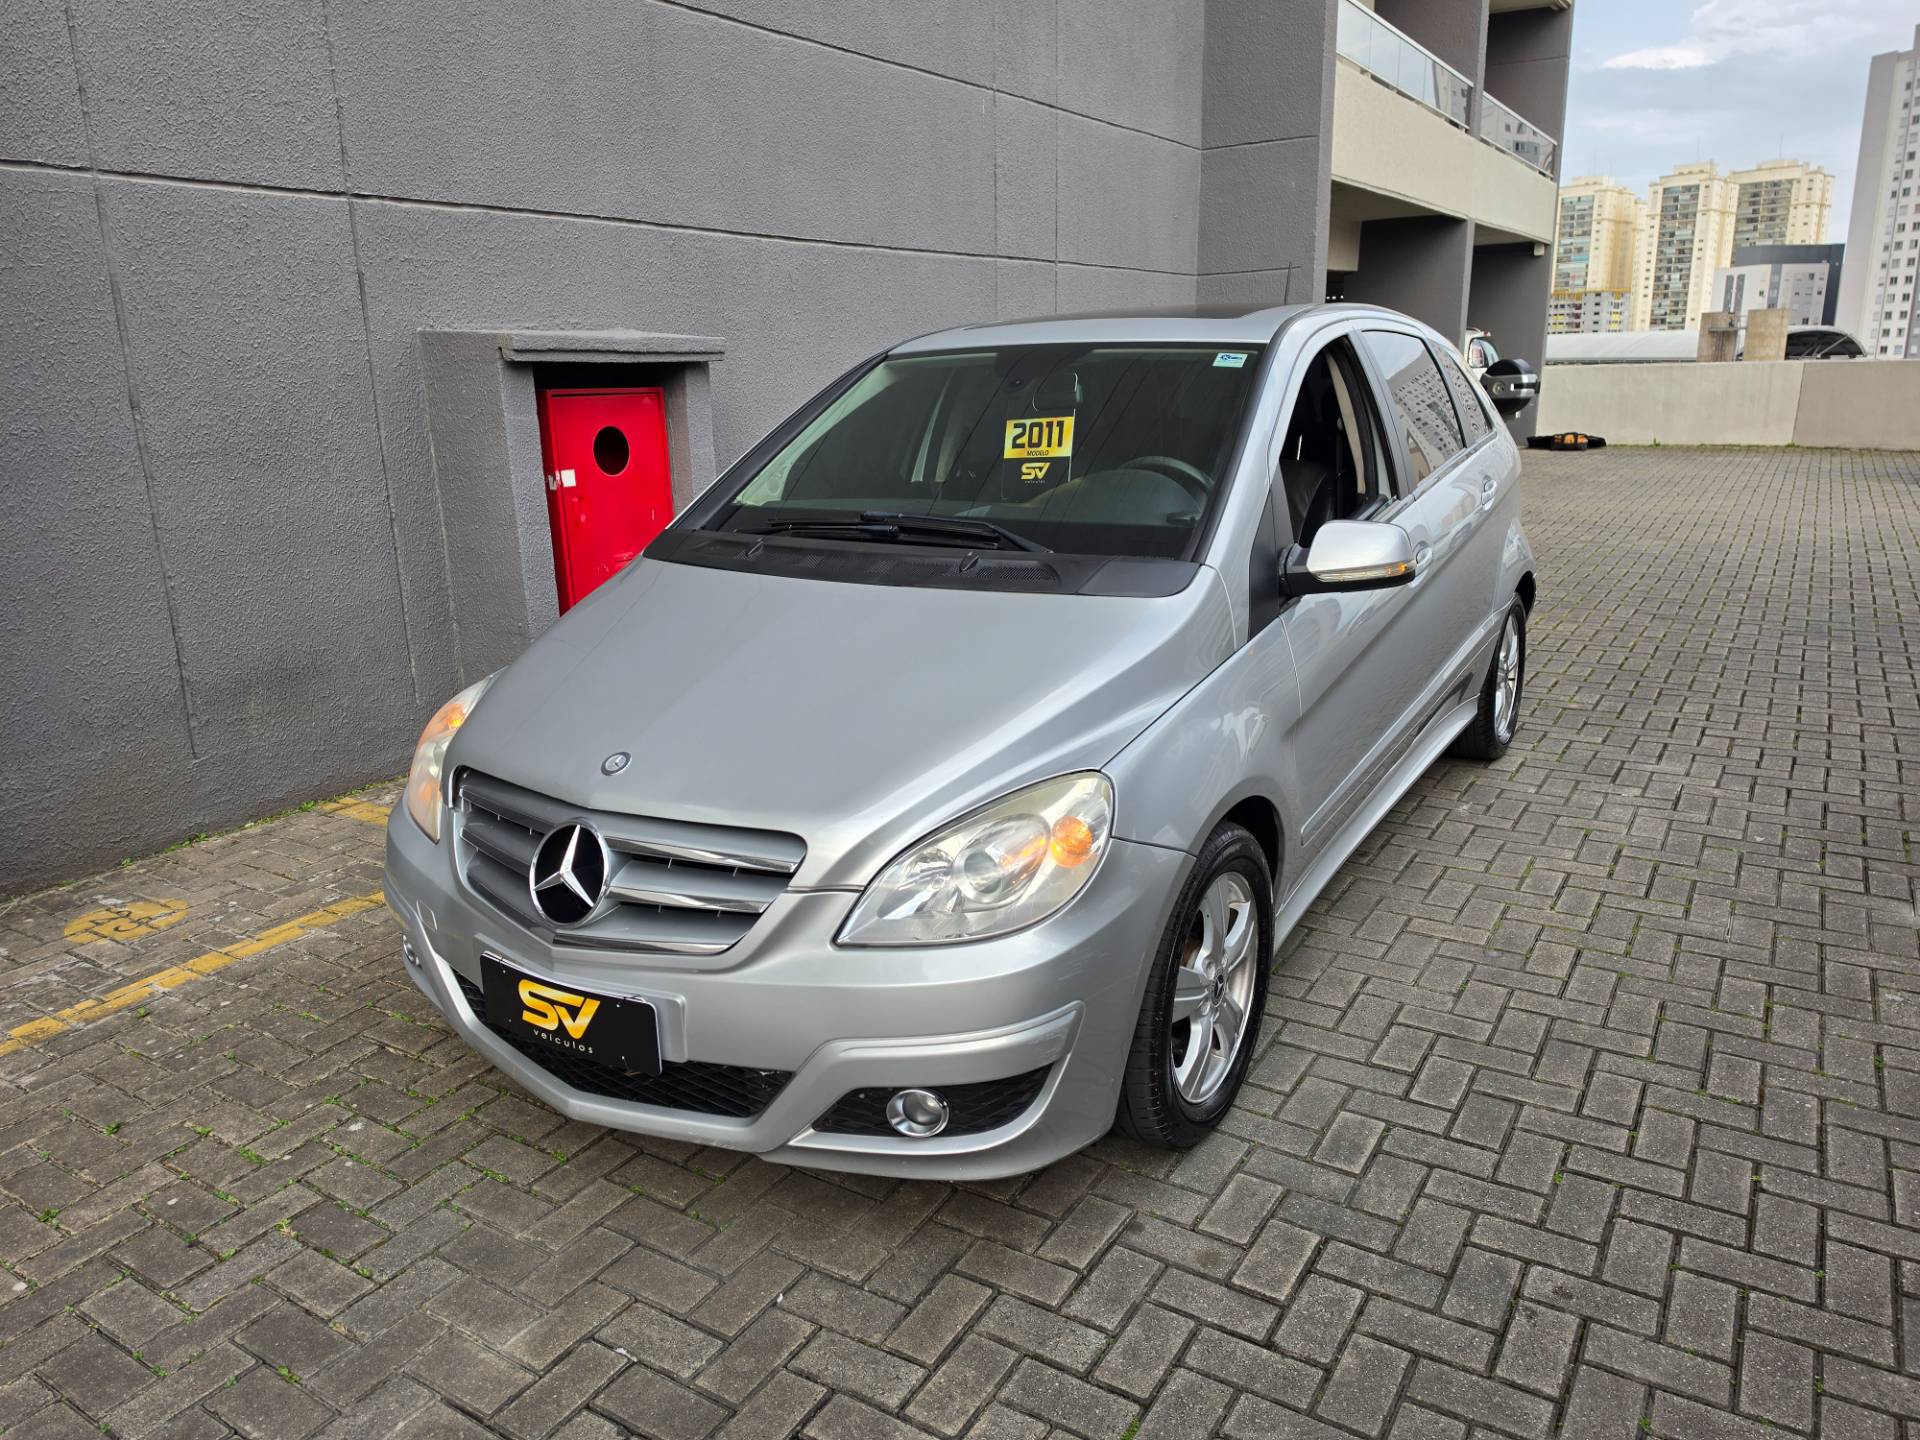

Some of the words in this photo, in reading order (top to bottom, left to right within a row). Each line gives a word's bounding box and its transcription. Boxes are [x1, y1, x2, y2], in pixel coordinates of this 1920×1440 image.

[1011, 420, 1065, 449] 2011
[1026, 449, 1050, 457] MODELO
[1020, 462, 1051, 480] SV
[518, 978, 601, 1040] SV
